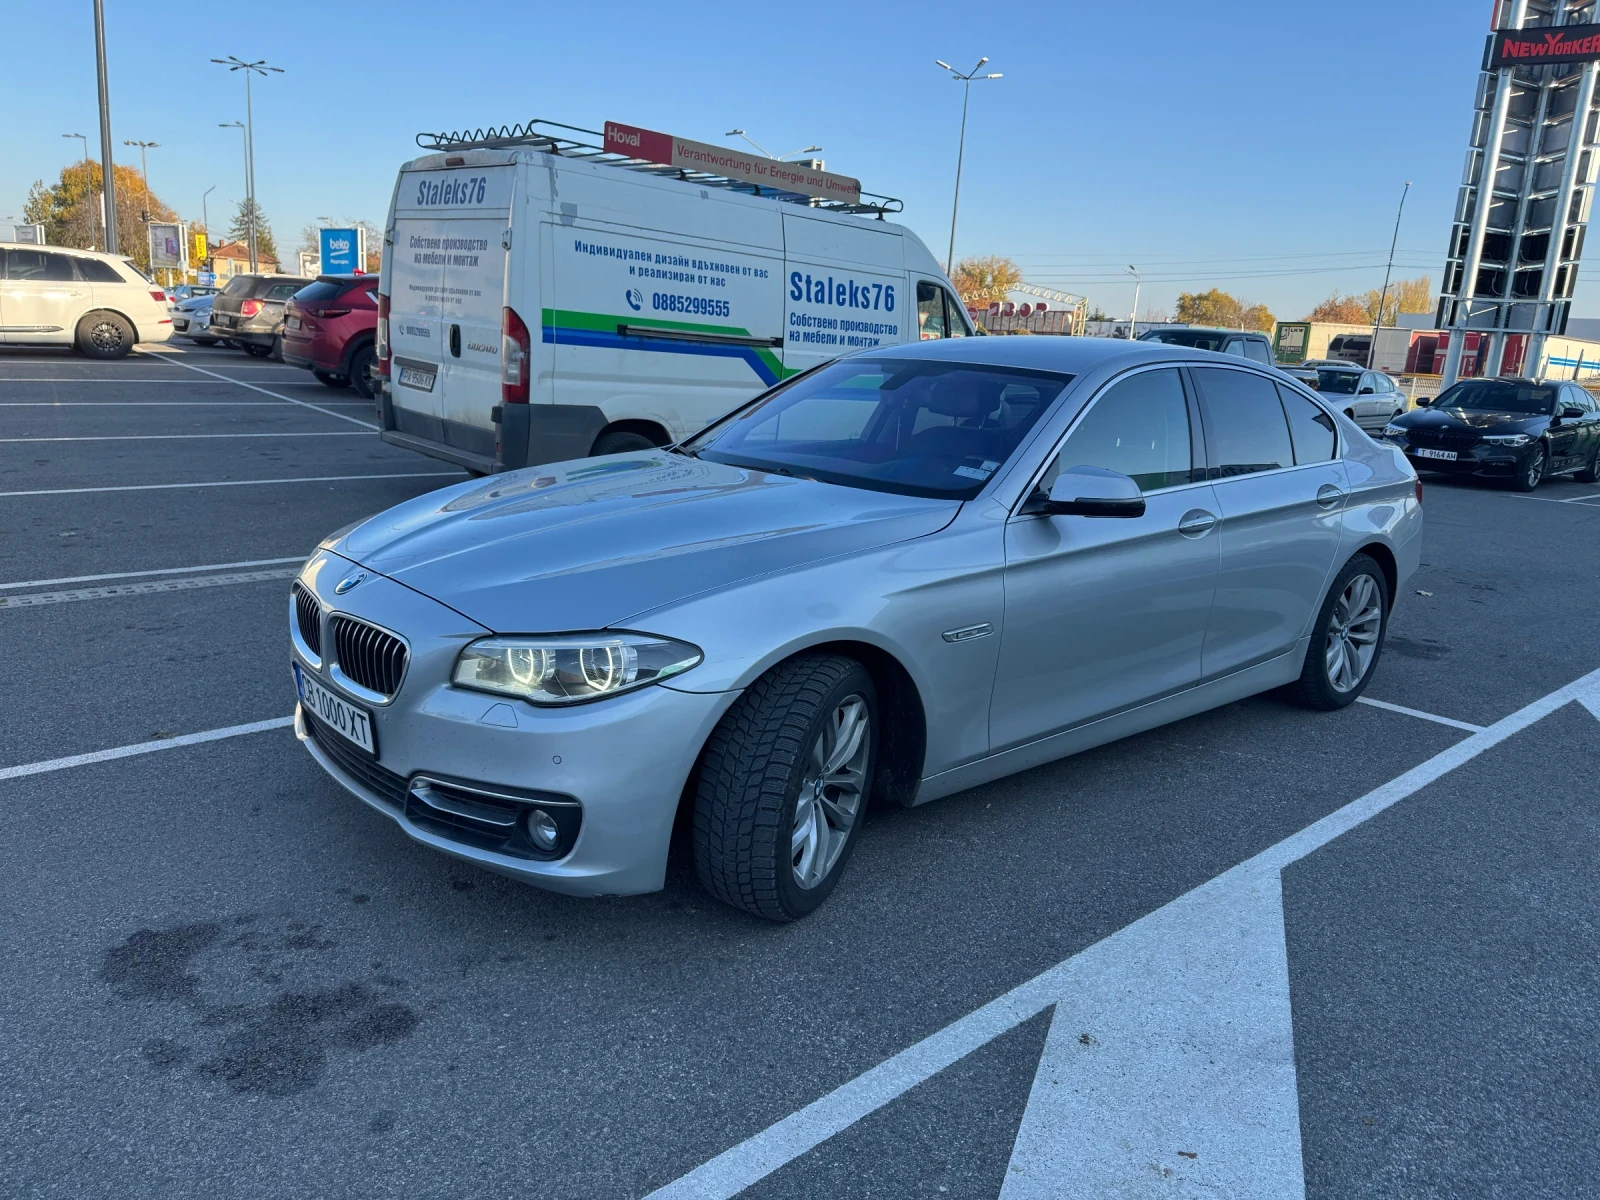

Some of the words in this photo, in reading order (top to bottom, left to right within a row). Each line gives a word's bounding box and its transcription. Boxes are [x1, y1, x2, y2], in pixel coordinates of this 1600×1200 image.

[607, 126, 640, 147] Hoval
[677, 144, 751, 174] Verantwortung
[754, 161, 768, 175] für
[770, 166, 804, 184] Energie
[806, 176, 824, 188] und
[826, 181, 857, 195] Umwelt
[417, 177, 486, 206] Staleks76
[329, 238, 349, 250] beko
[410, 235, 441, 249] Собствено
[441, 238, 488, 252] производство
[414, 252, 422, 264] на
[422, 252, 446, 266] мебели
[447, 254, 452, 266] и
[452, 255, 479, 267] монтаж
[574, 239, 652, 262] Индивидуален
[655, 253, 689, 268] дизайн
[692, 259, 740, 275] вдъхновен
[742, 266, 752, 277] от
[754, 268, 769, 279] вас
[629, 265, 636, 275] и
[638, 266, 695, 283] реализиран
[698, 275, 708, 285] от
[710, 276, 726, 287] нас
[790, 271, 895, 312] Staleks76
[652, 292, 731, 317] 0885299555
[789, 312, 838, 329] Собствено
[840, 319, 898, 336] производство
[789, 330, 800, 342] на
[802, 331, 837, 345] мебели
[839, 334, 846, 346] и
[847, 335, 880, 348] монтаж
[1429, 450, 1445, 459] 9164
[301, 673, 316, 708] CB
[316, 686, 346, 732] 1000
[347, 706, 367, 745] XT
